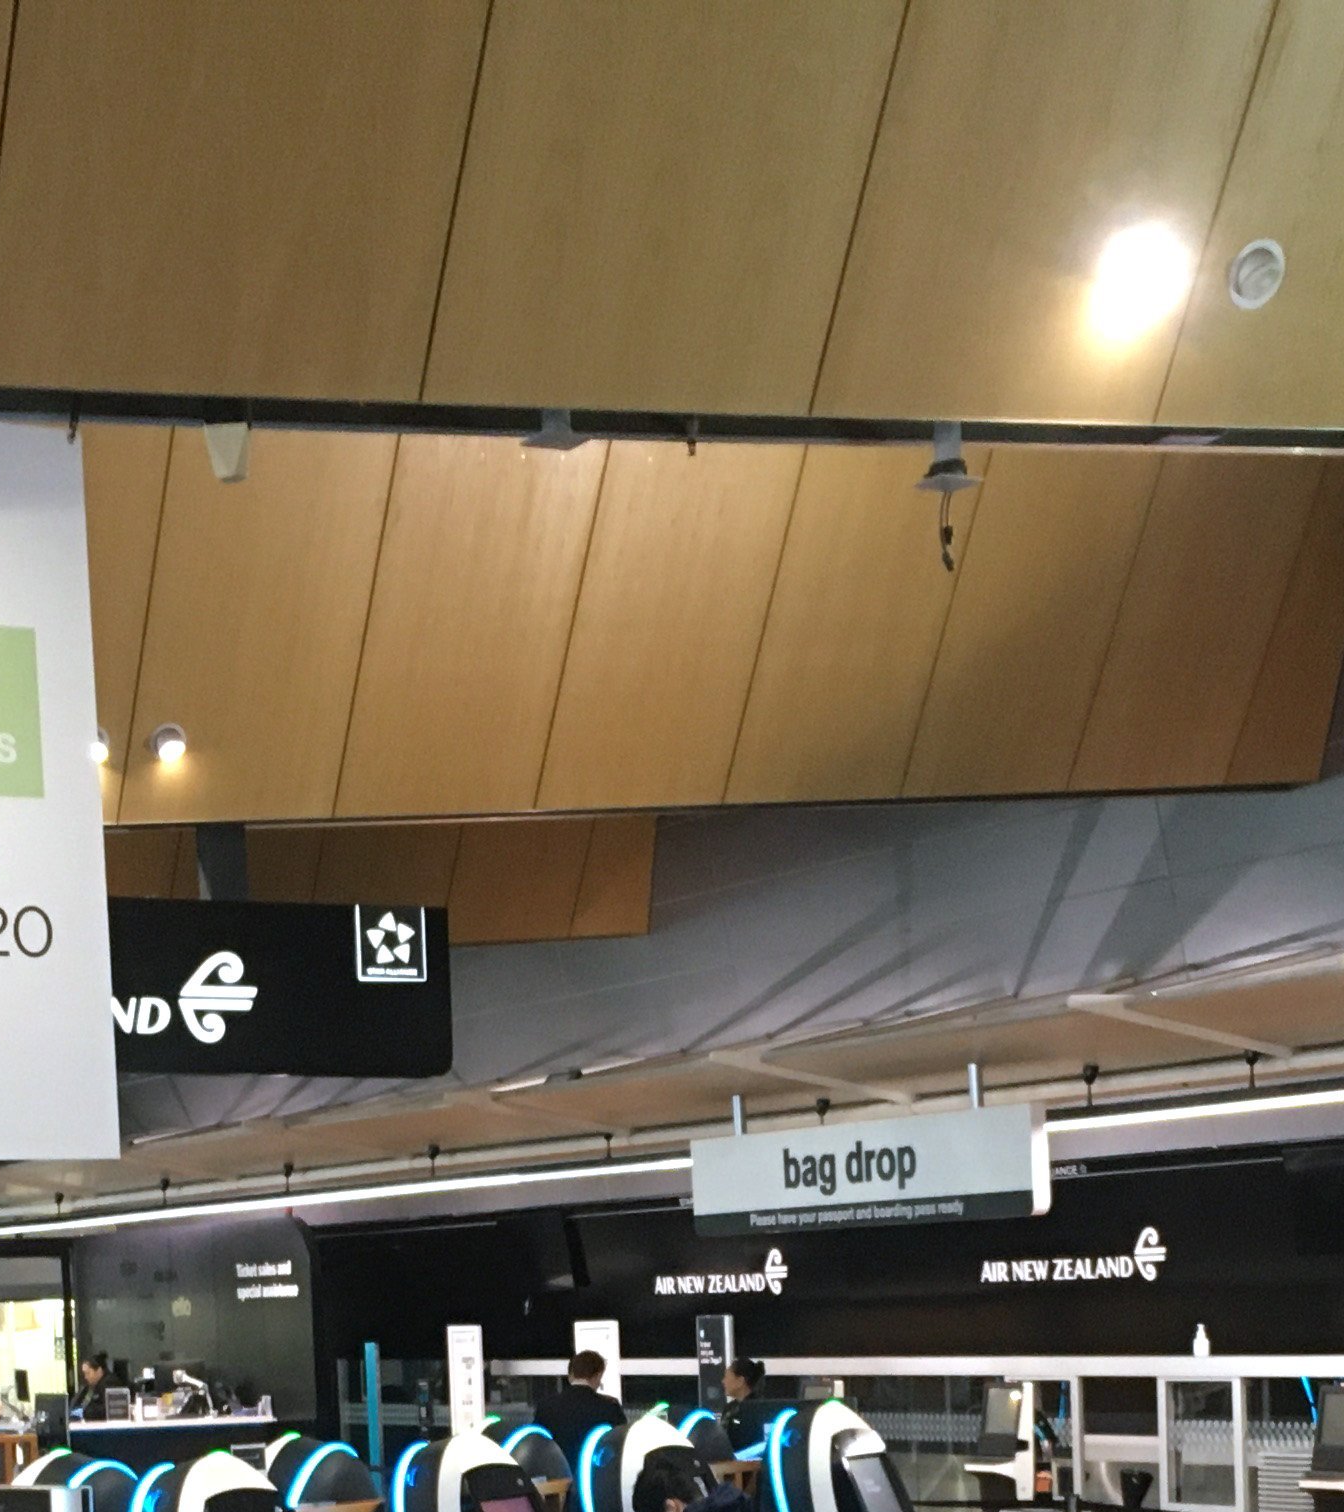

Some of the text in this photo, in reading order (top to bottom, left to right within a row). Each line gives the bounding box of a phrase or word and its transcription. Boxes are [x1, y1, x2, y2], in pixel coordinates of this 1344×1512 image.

[783, 1140, 917, 1196] bag drop
[981, 1254, 1133, 1283] AIR NEW ZEALAND
[655, 1272, 766, 1295] AIR NEW ZEALAND
